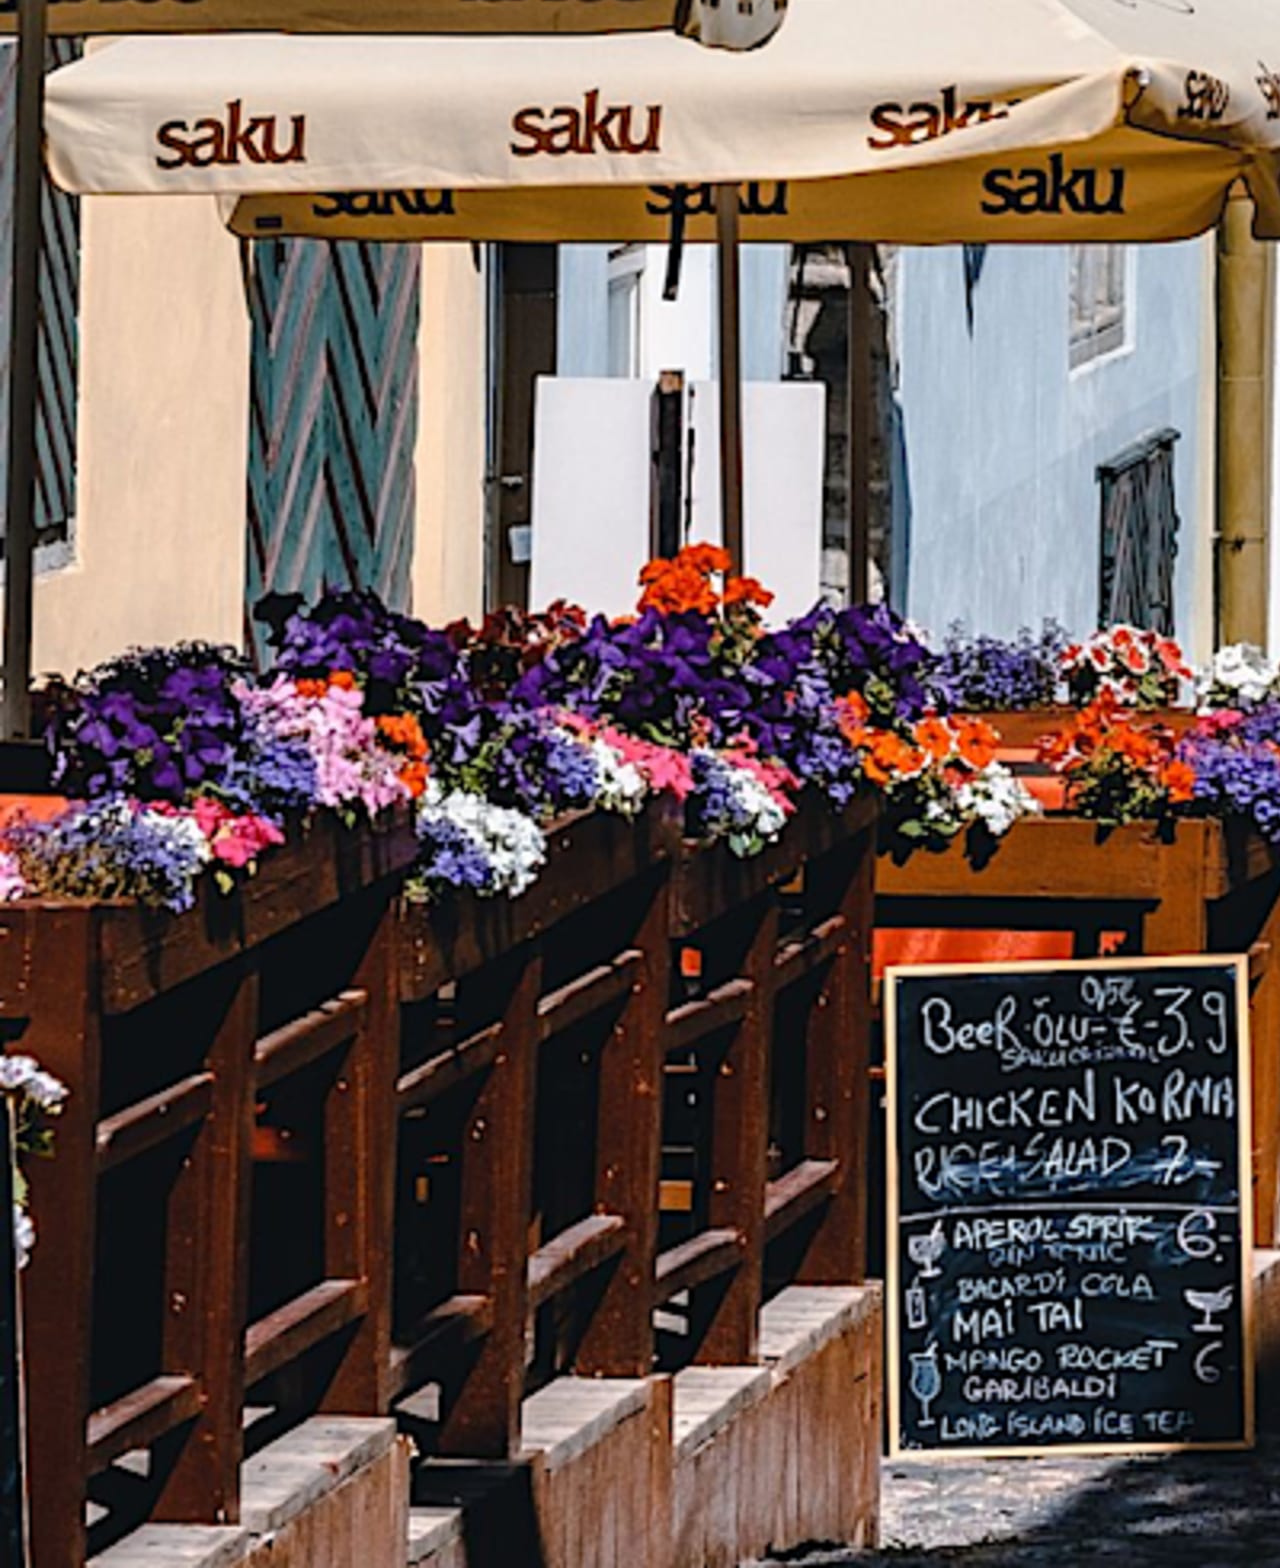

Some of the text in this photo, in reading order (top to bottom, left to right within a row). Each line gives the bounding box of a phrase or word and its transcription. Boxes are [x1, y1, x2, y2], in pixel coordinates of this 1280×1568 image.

[155, 98, 306, 171] saku
[510, 87, 662, 157] saku
[867, 84, 1024, 149] sak
[980, 152, 1125, 215] saku
[914, 1068, 1235, 1134] CHICKEN KORMA
[1019, 1132, 1132, 1182] SALAD
[953, 1215, 1060, 1250] APEROL
[1080, 1273, 1154, 1300] COLA
[1028, 1296, 1084, 1332] TAI
[944, 1339, 1178, 1374] MANGO ROCKET
[940, 1414, 1003, 1440] LONG
